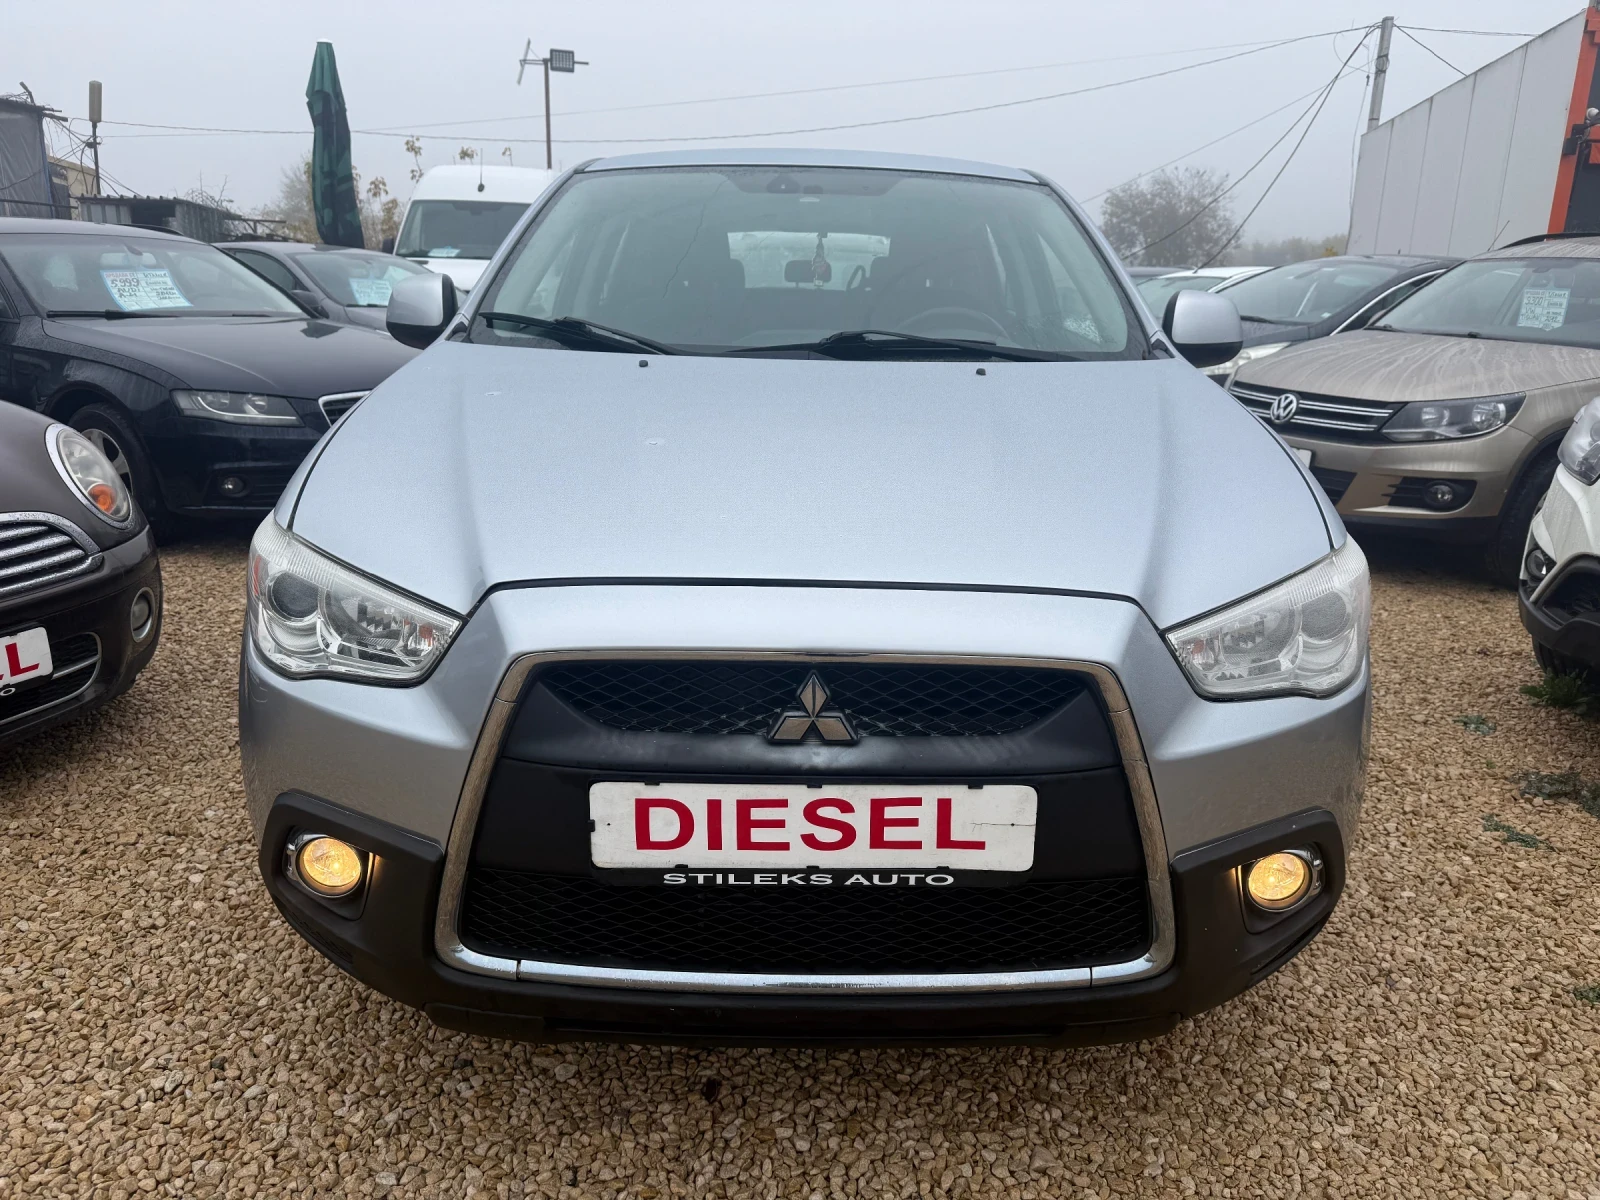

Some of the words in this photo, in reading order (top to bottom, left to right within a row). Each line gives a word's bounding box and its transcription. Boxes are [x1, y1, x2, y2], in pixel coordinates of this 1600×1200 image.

[0, 642, 40, 681] L
[634, 797, 986, 851] DIESEL
[663, 873, 833, 885] STILEKS
[844, 874, 954, 886] AUTO
